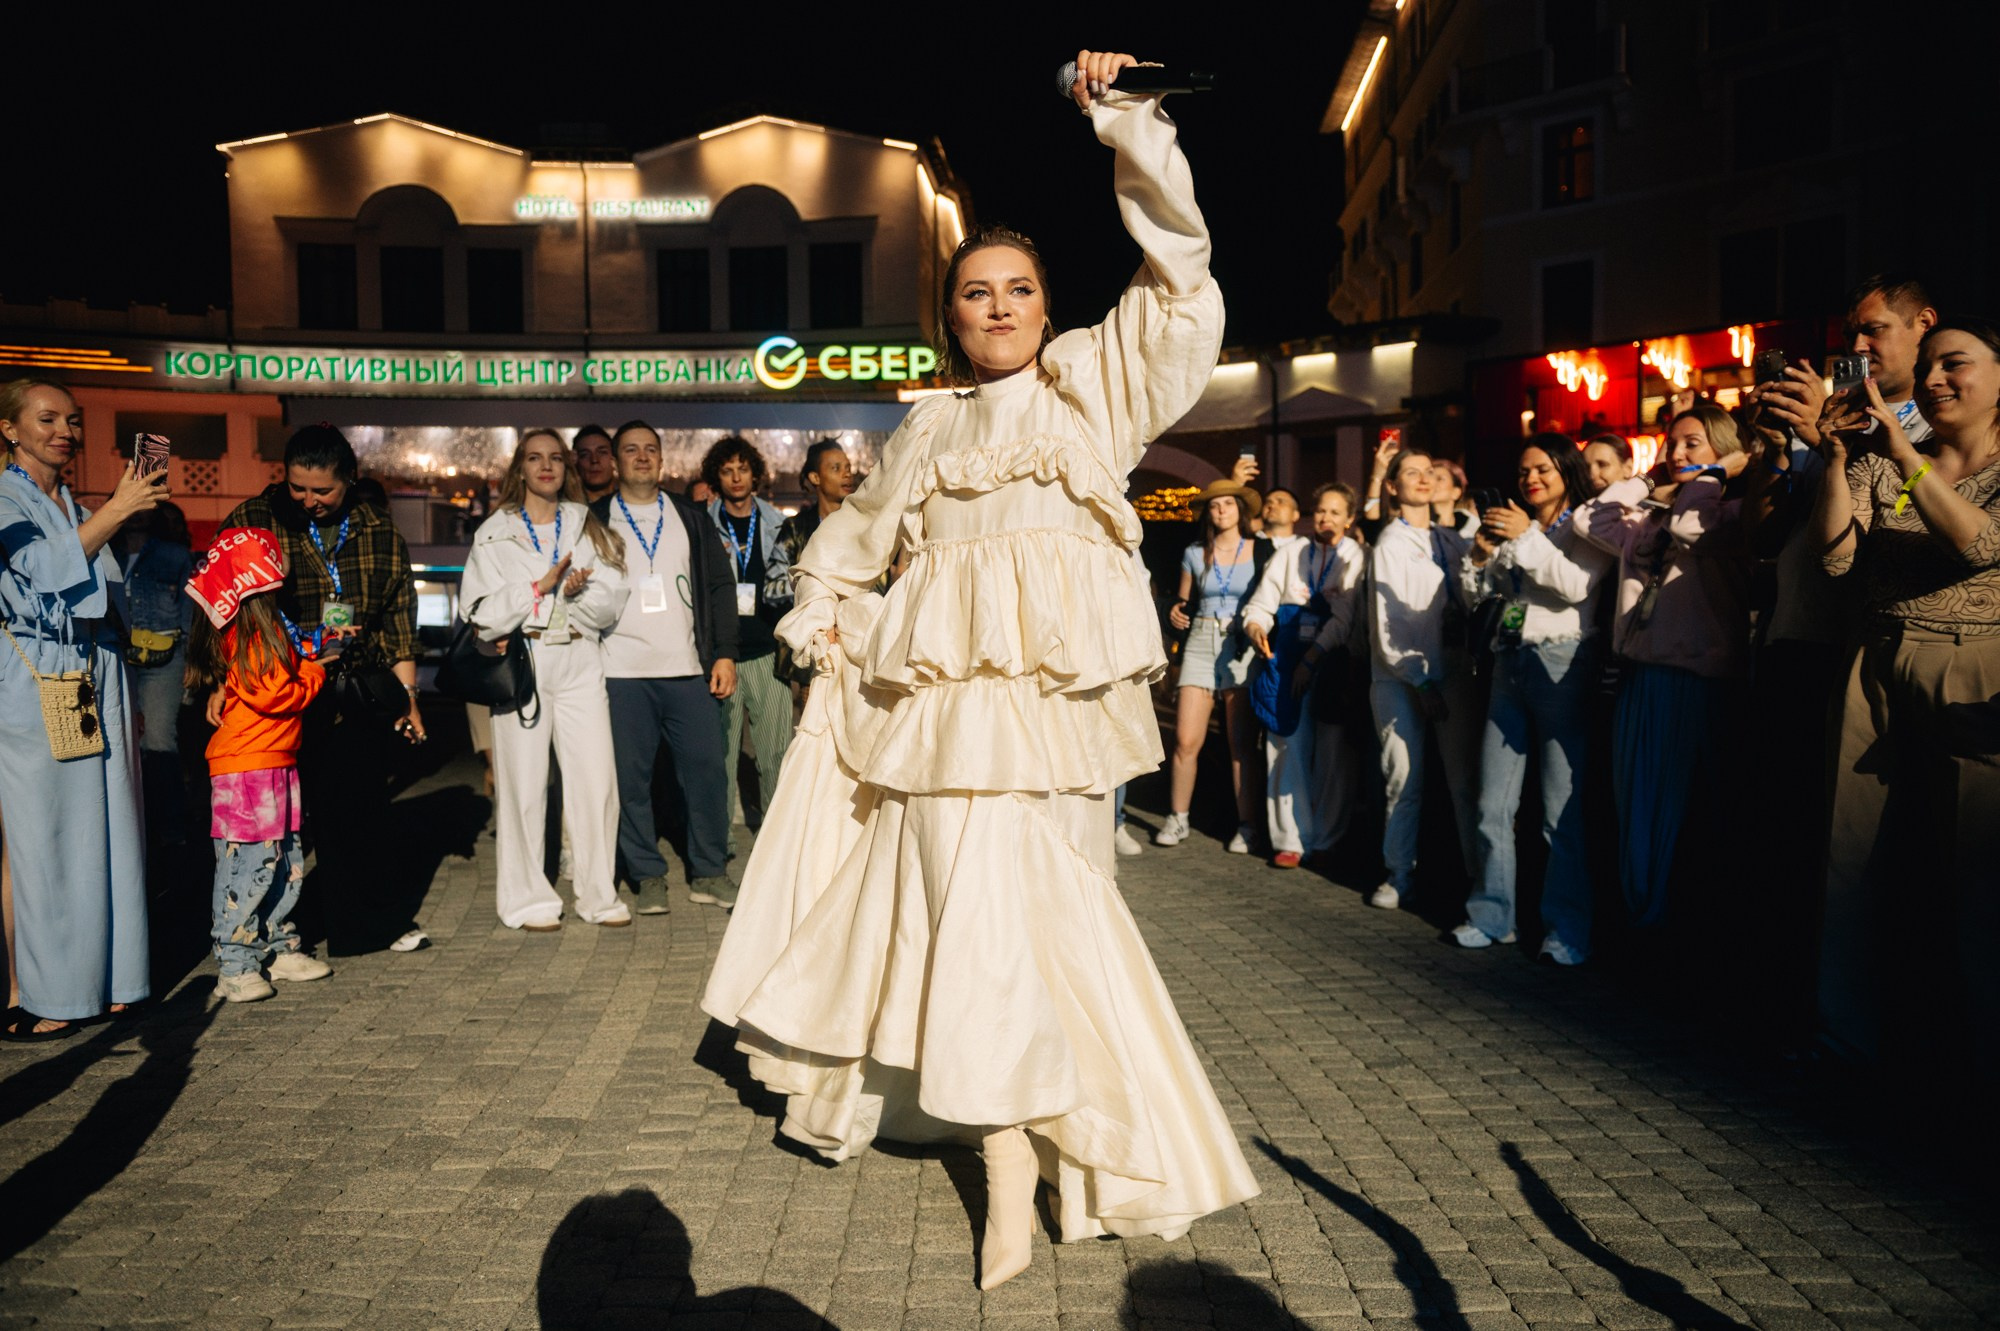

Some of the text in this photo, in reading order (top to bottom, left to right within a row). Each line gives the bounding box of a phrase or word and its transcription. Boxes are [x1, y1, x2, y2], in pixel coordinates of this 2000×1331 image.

[517, 198, 711, 217] HOTEL RESTAURANT
[165, 350, 755, 388] КОРПОРАТИВНЫЙ ЦЕНТР СБЕРБАНКА
[817, 344, 938, 382] СБЕР
